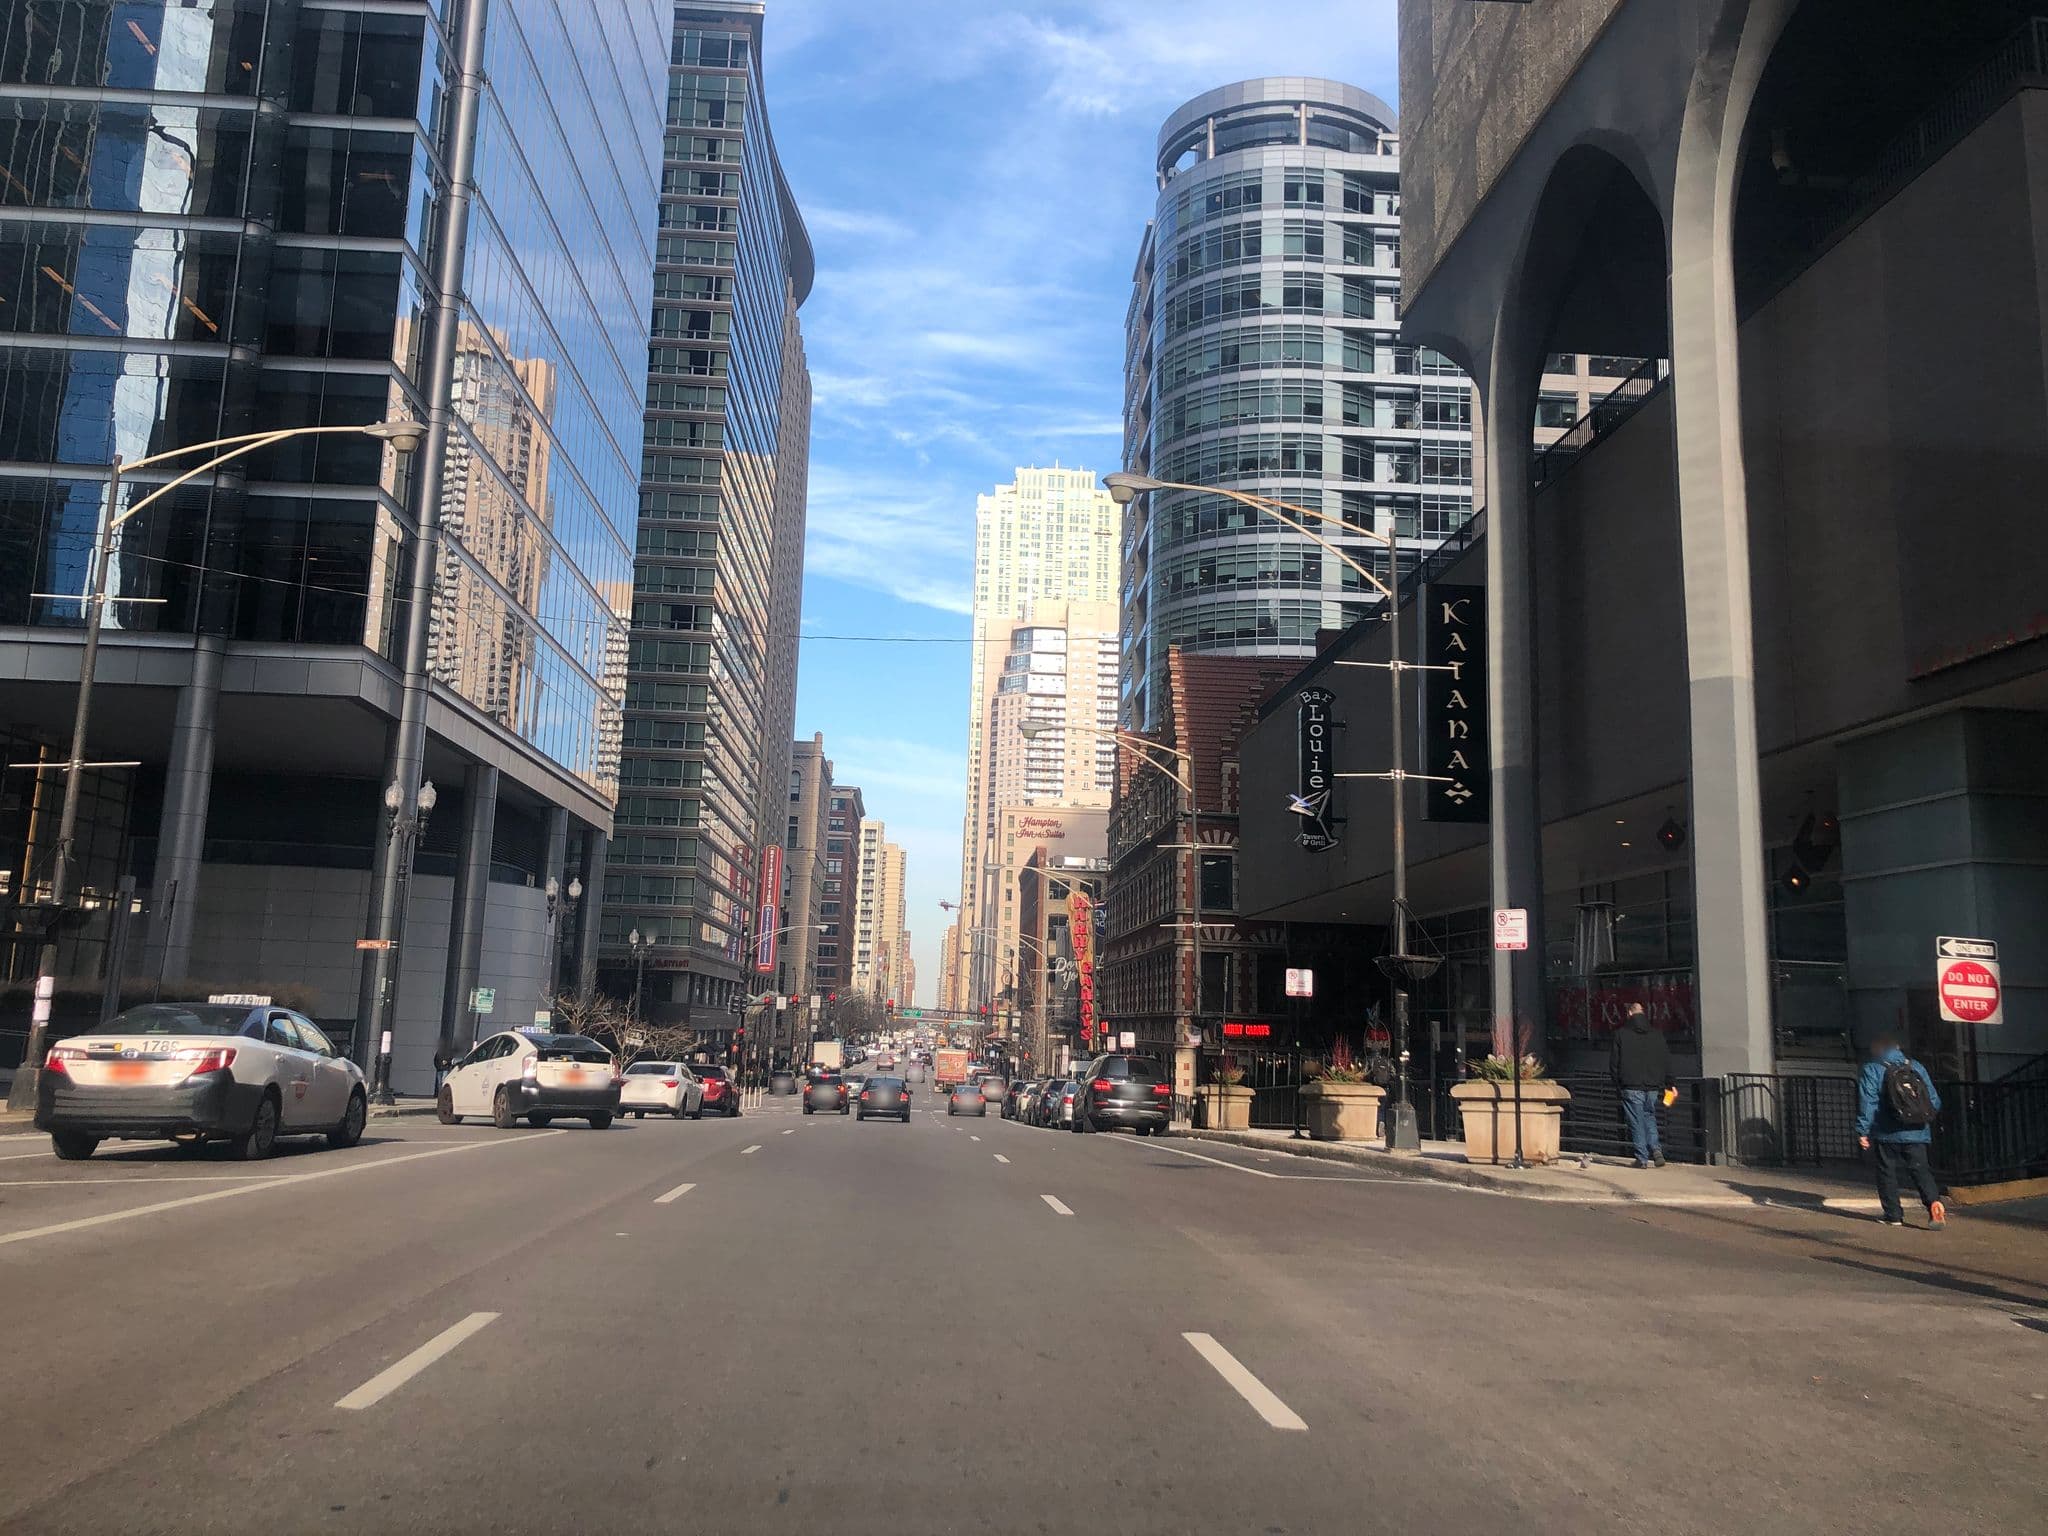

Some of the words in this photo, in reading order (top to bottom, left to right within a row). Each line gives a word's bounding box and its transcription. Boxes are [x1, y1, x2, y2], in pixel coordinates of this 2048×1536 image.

[1441, 599, 1471, 770] KATANA
[1300, 691, 1332, 704] Bar
[1309, 704, 1324, 789] Louie
[1019, 816, 1062, 829] Hampton
[1955, 944, 1971, 953] ONE
[1975, 945, 1992, 954] WAY
[1947, 971, 1964, 983] DO
[1967, 973, 1991, 985] NOT
[1953, 999, 1988, 1011] ENTER
